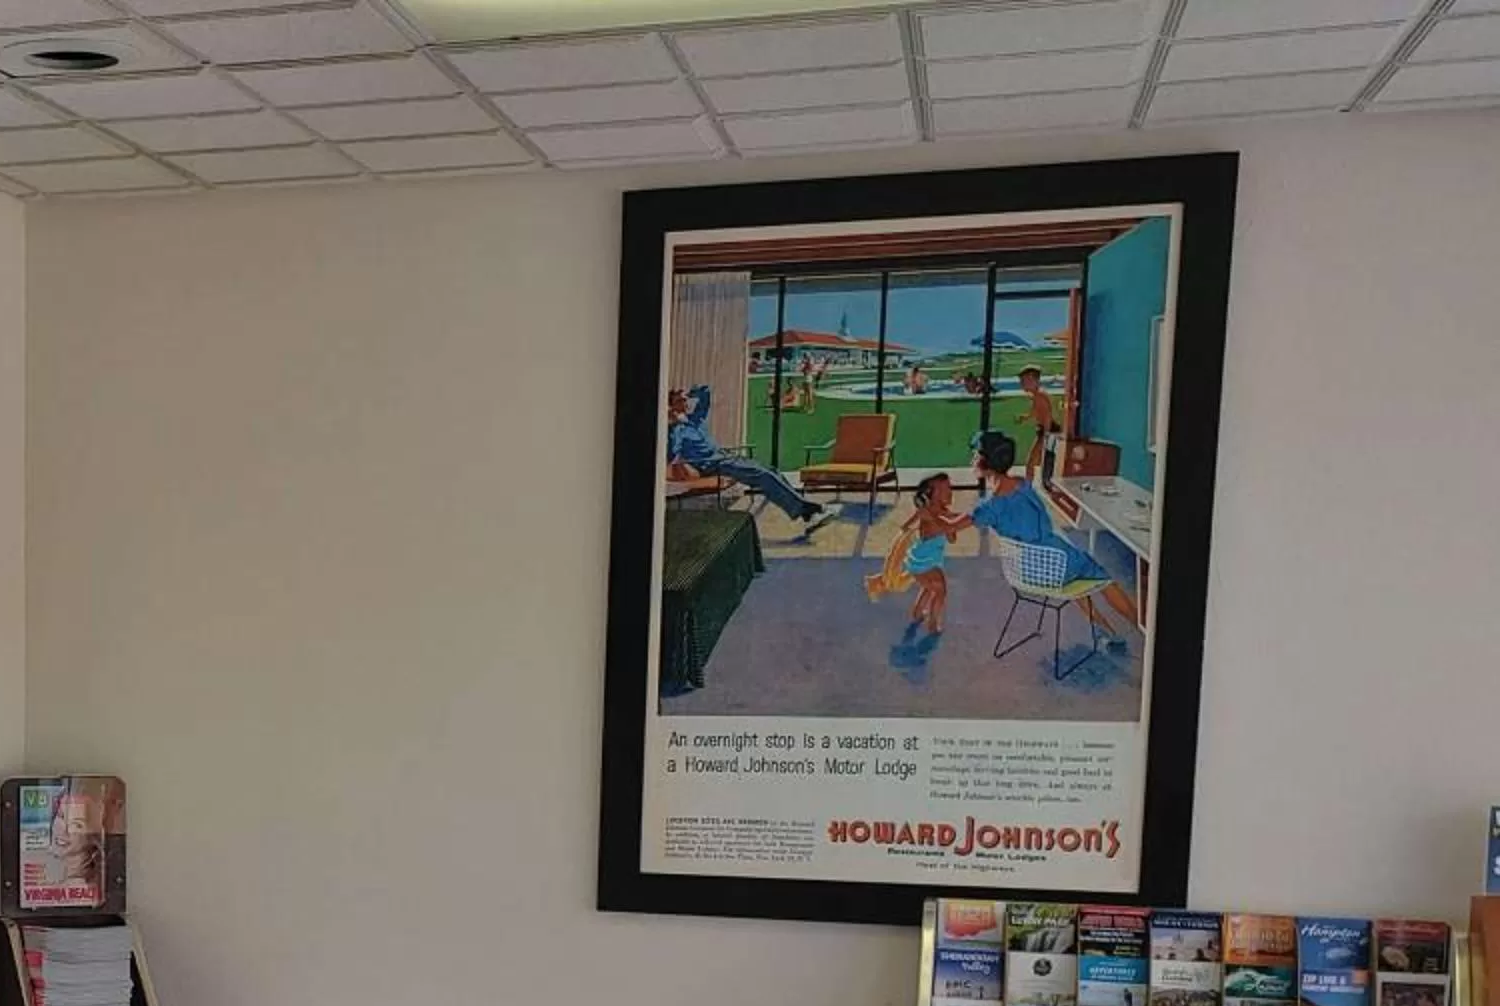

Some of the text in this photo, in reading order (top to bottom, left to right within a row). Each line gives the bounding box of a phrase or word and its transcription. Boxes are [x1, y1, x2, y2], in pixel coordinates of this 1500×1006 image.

[668, 731, 920, 752] An overnight stop is a vacation at
[666, 755, 917, 779] a Howard Johnson's Motor Lodge
[828, 819, 957, 848] HOWARD
